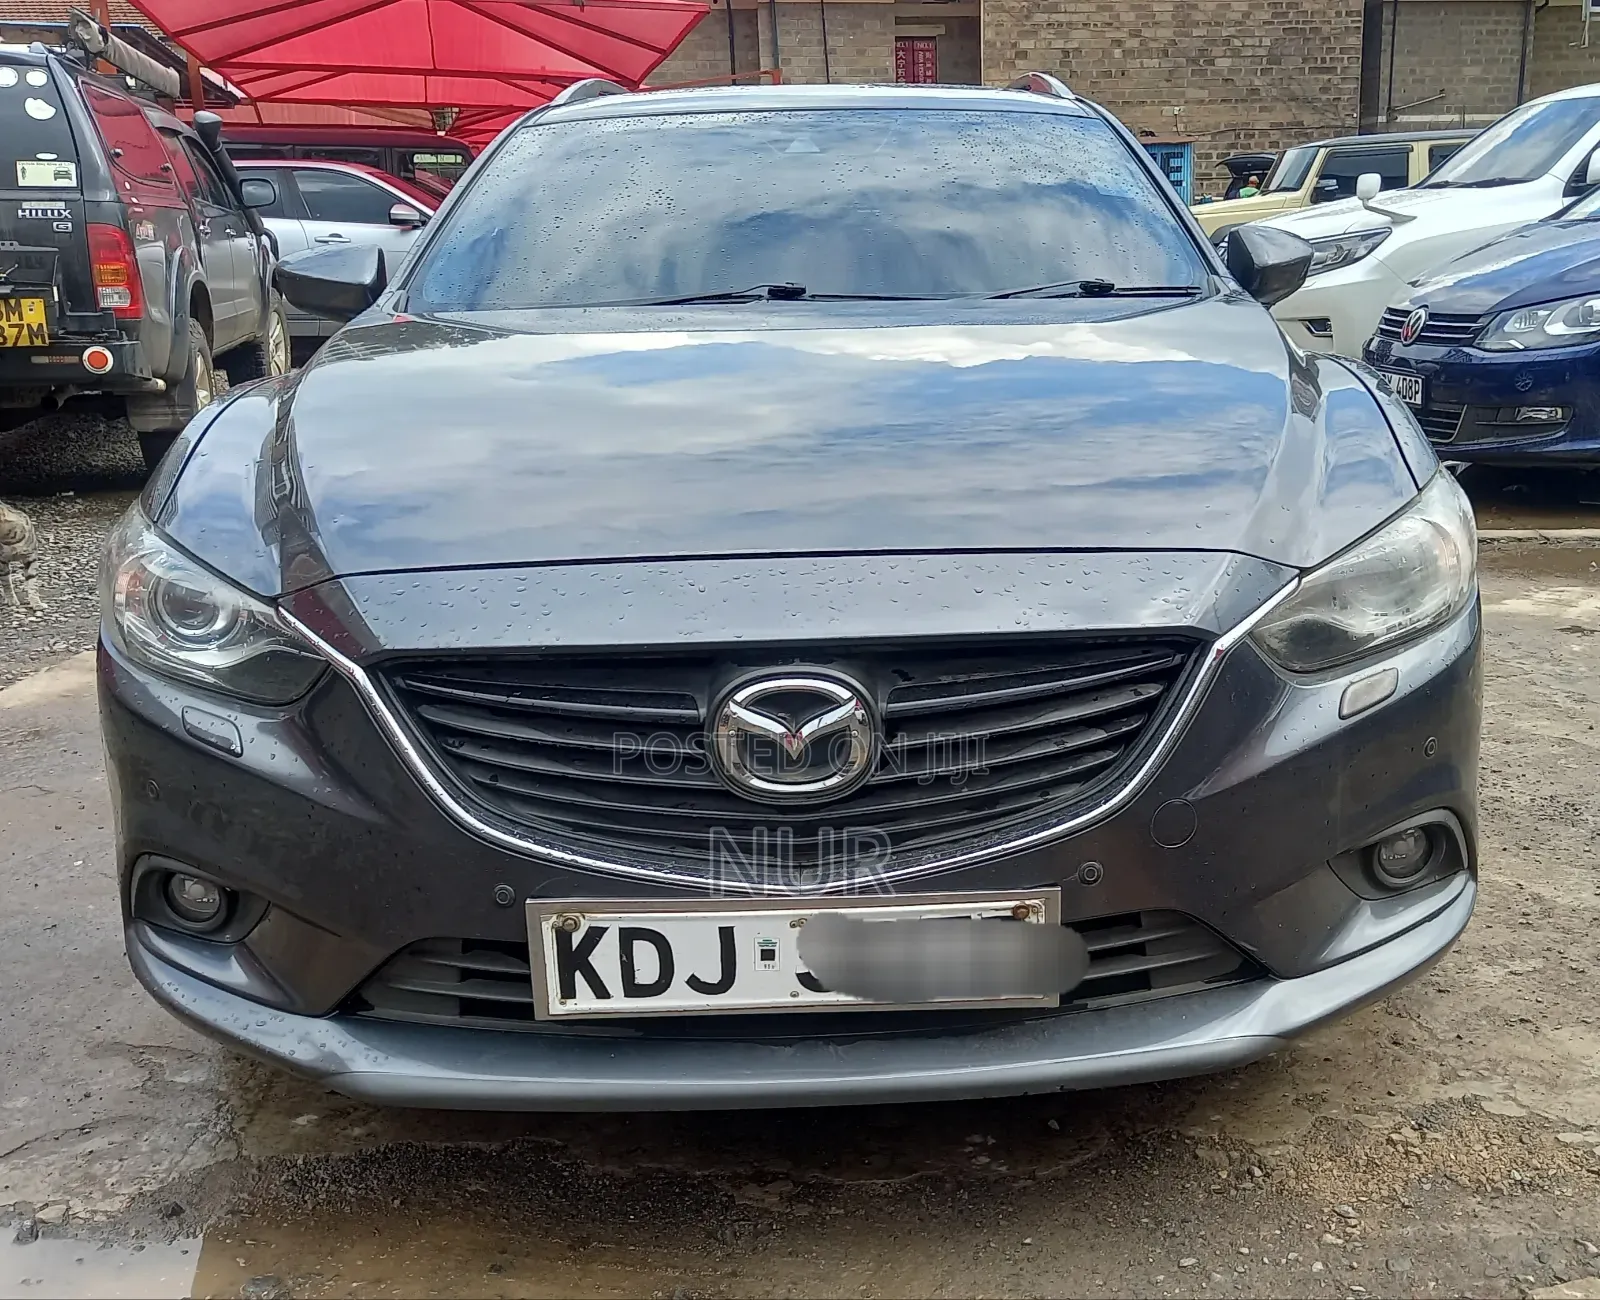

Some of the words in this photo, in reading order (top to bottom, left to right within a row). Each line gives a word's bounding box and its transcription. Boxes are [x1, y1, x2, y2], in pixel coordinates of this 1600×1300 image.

[17, 209, 73, 219] HILUX
[53, 221, 73, 233] G
[555, 924, 737, 1000] KDJ
